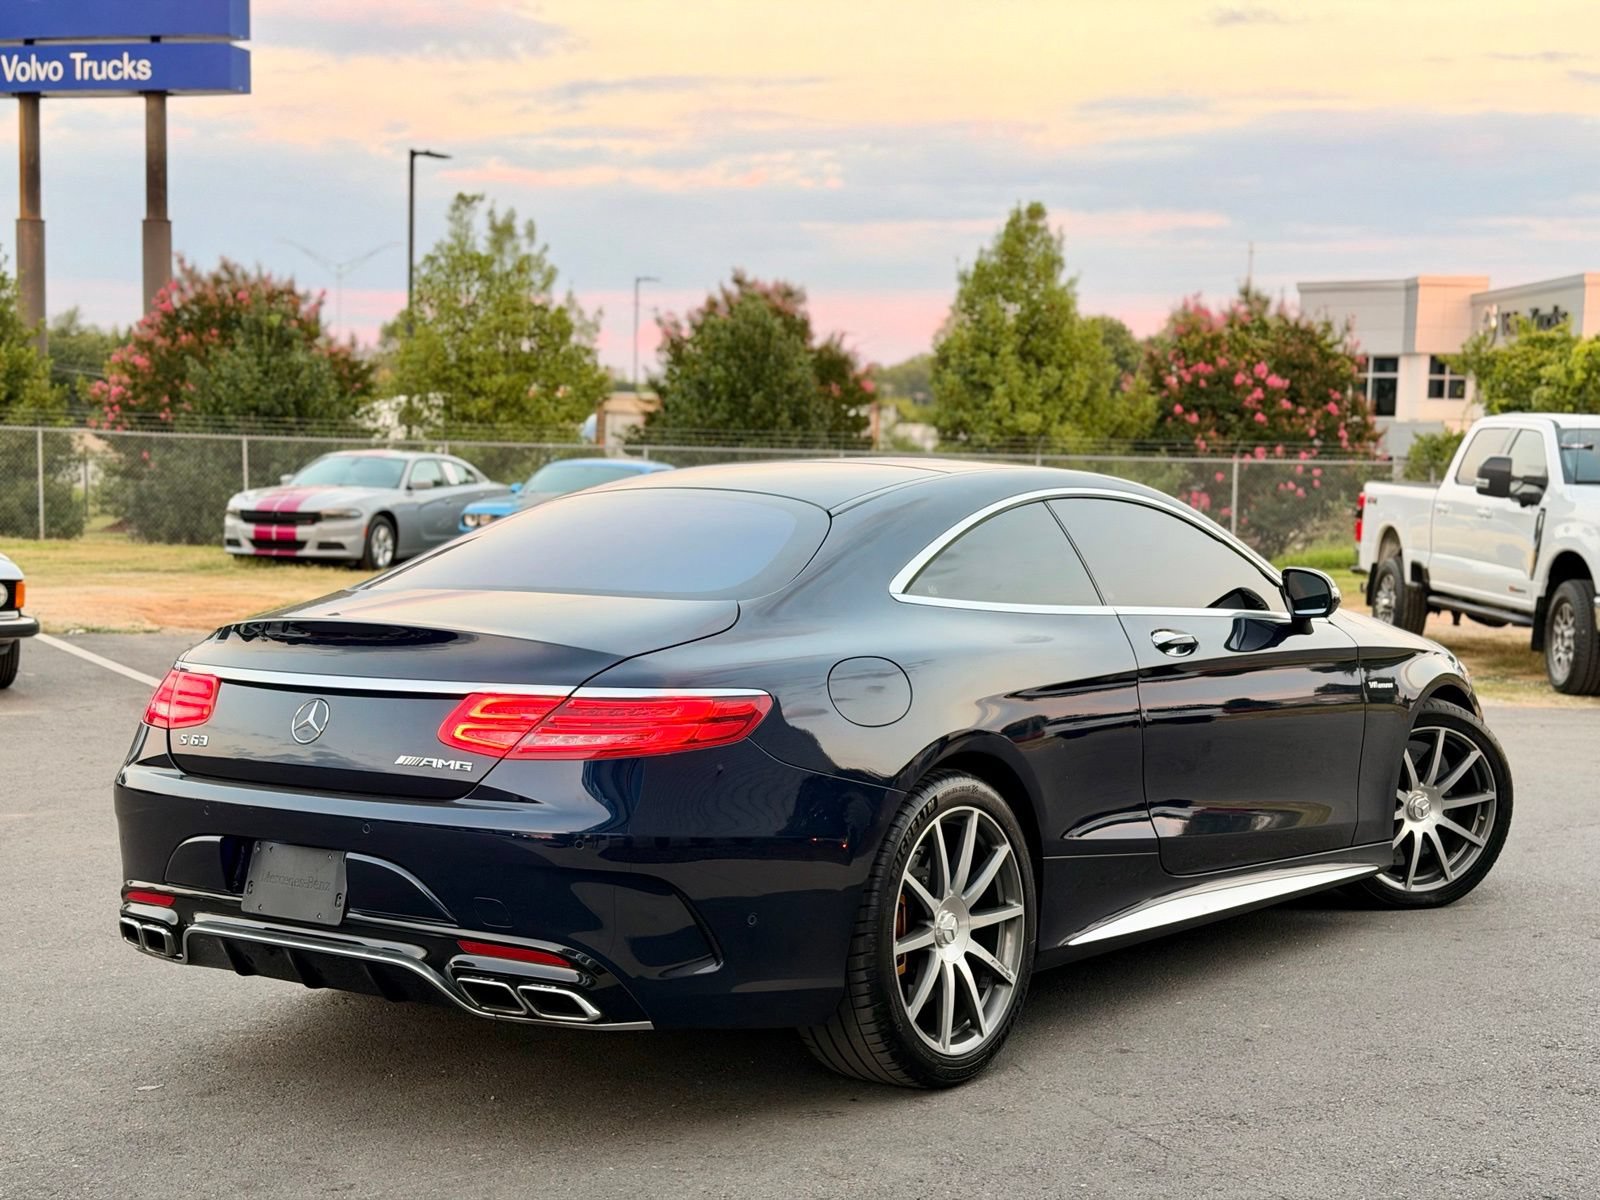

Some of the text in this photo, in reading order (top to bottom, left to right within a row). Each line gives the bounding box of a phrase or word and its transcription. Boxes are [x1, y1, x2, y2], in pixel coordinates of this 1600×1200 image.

[1, 52, 152, 82] Volvo Trucks
[179, 734, 209, 747] S 63
[419, 757, 473, 772] AMG
